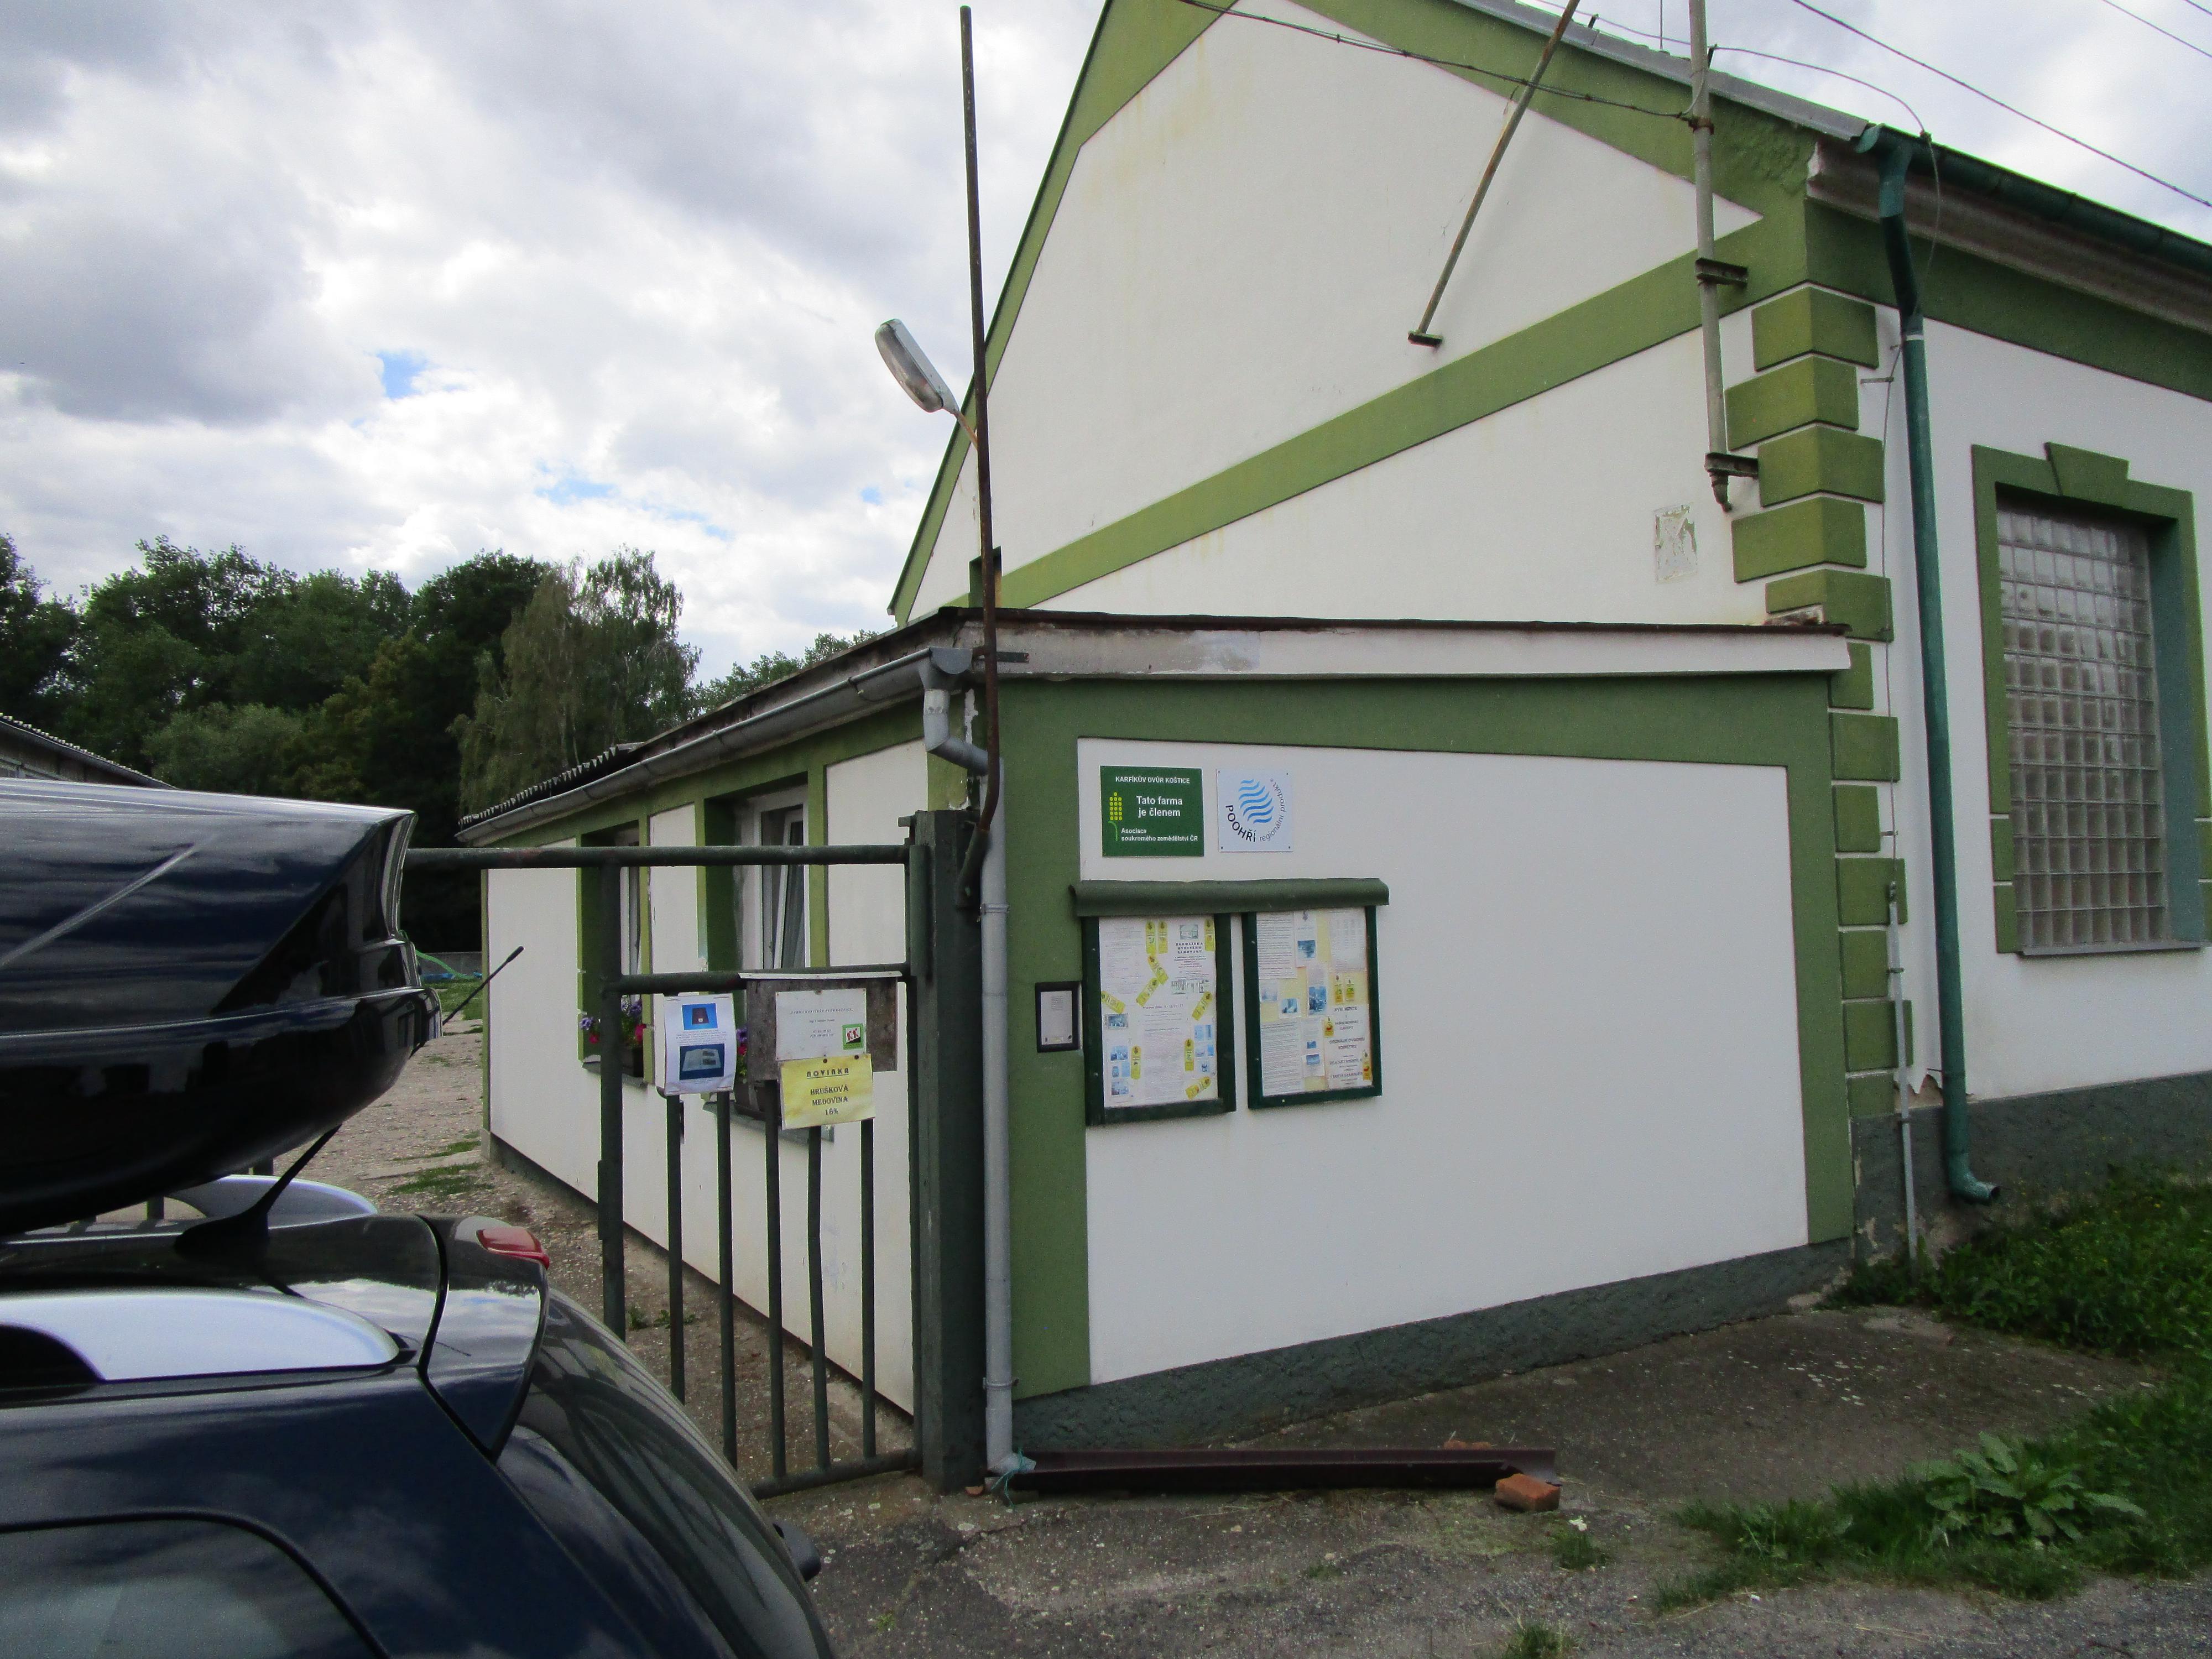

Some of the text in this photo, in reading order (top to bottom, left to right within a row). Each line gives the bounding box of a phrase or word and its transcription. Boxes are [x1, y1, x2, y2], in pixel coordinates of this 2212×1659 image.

[1136, 795, 1183, 805] Tato farma
[1138, 807, 1181, 818] je členem
[1225, 805, 1256, 842] POOHŘÍ
[1259, 815, 1284, 841] regionální
[806, 1068, 849, 1078] NOVINKA
[810, 1084, 848, 1095] HRUŠKOVÁ
[812, 1097, 848, 1106] MEDOVINA
